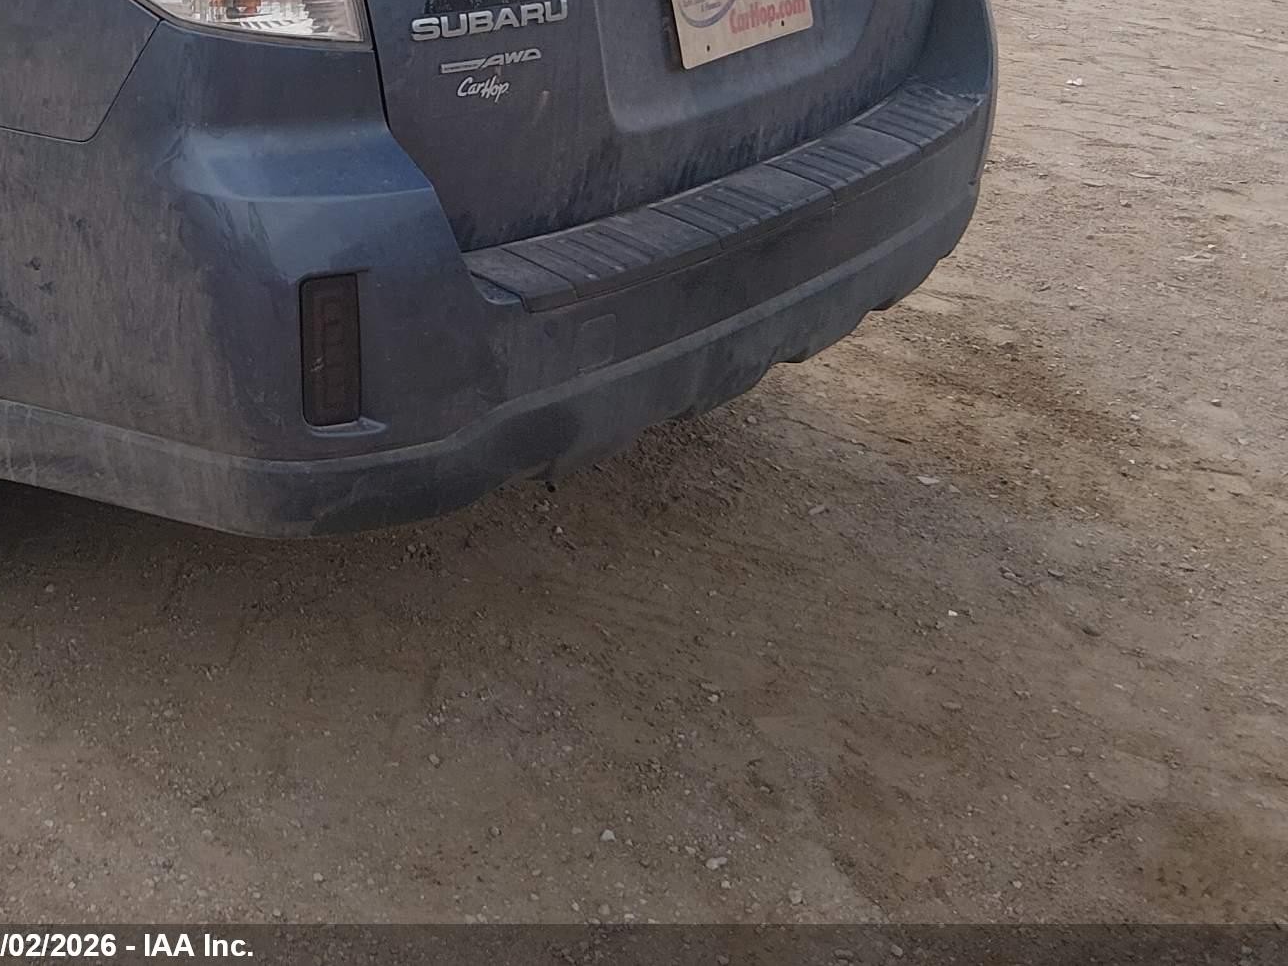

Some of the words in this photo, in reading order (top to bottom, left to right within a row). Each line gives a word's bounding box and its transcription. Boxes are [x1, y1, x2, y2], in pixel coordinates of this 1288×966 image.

[411, 0, 569, 42] SUBARU
[480, 48, 543, 70] AWD
[457, 75, 511, 103] CarHop
